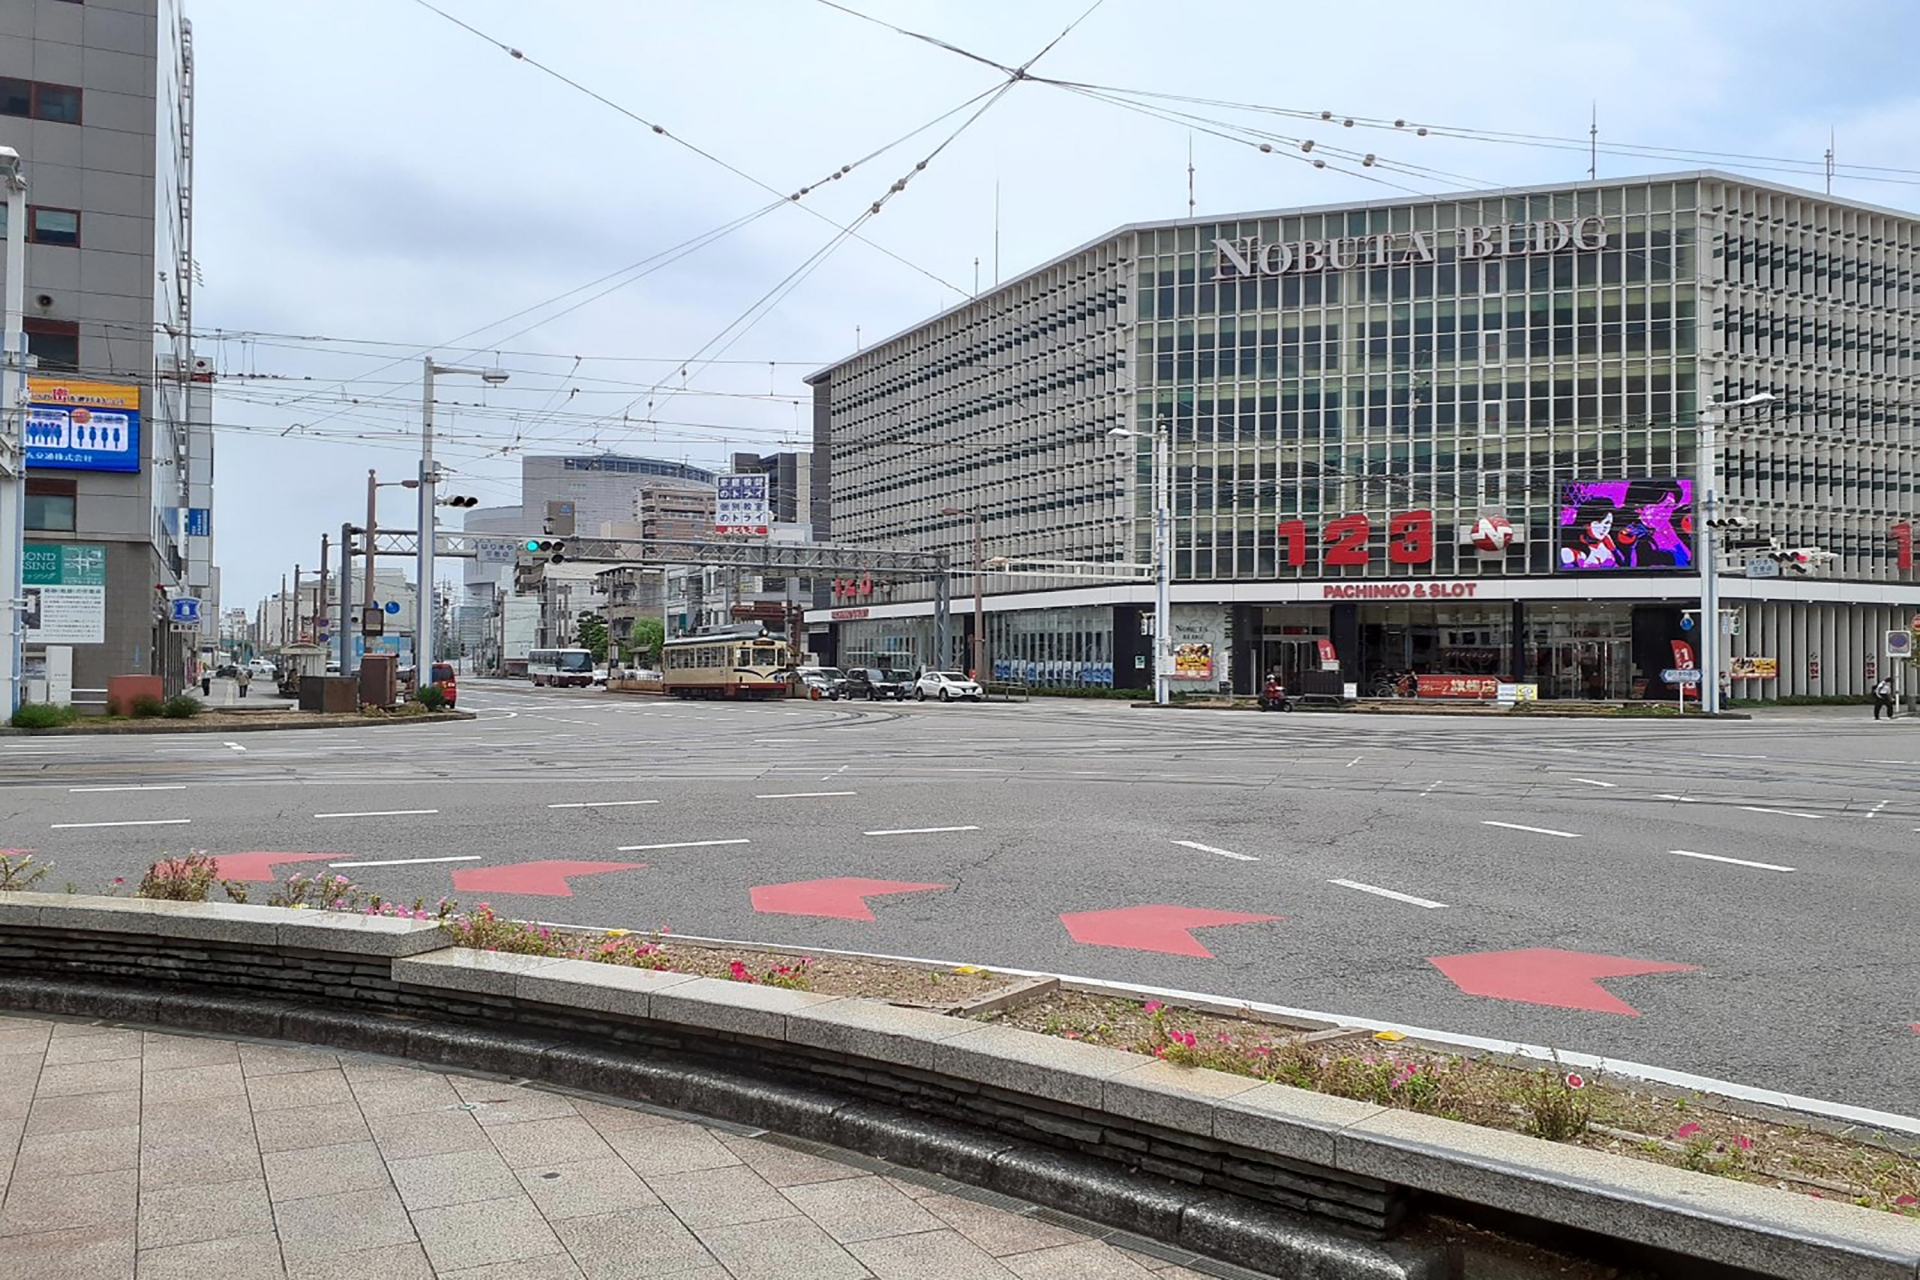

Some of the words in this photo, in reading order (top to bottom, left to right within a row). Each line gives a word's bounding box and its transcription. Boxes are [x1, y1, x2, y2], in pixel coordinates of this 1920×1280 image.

[1211, 231, 1435, 280] NOBUTA
[1456, 216, 1609, 260] BLDG
[720, 490, 763, 499] のトライ
[720, 513, 763, 522] のトライ
[1278, 509, 1433, 566] 123
[1323, 584, 1410, 599] PACHINKO
[1413, 584, 1426, 598] &
[1429, 583, 1477, 598] SLOT
